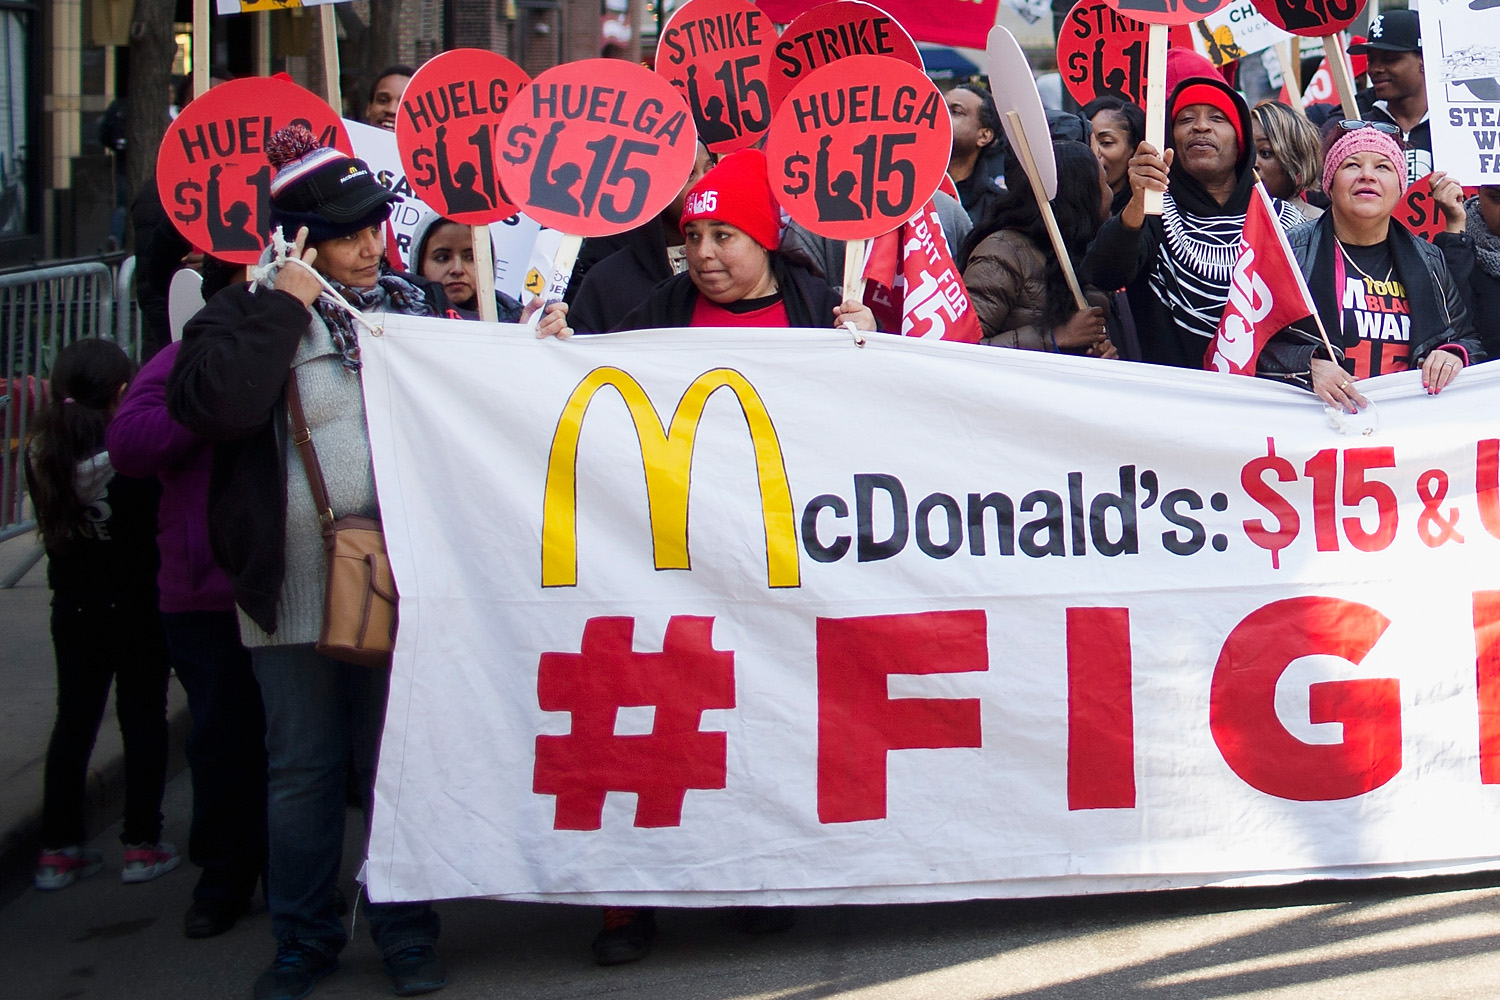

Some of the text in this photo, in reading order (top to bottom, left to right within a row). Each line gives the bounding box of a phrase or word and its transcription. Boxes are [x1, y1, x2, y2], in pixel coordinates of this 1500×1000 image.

[665, 11, 762, 65] STRIKE
[775, 18, 894, 79] STRIKE
[404, 79, 530, 133] HUELG
[532, 84, 687, 147] HUELGA
[792, 85, 940, 133] HUELGA
[503, 122, 660, 224] $15
[783, 132, 917, 219] $15
[937, 268, 968, 317] FOR
[1240, 436, 1400, 569] $15
[1417, 469, 1464, 548] &
